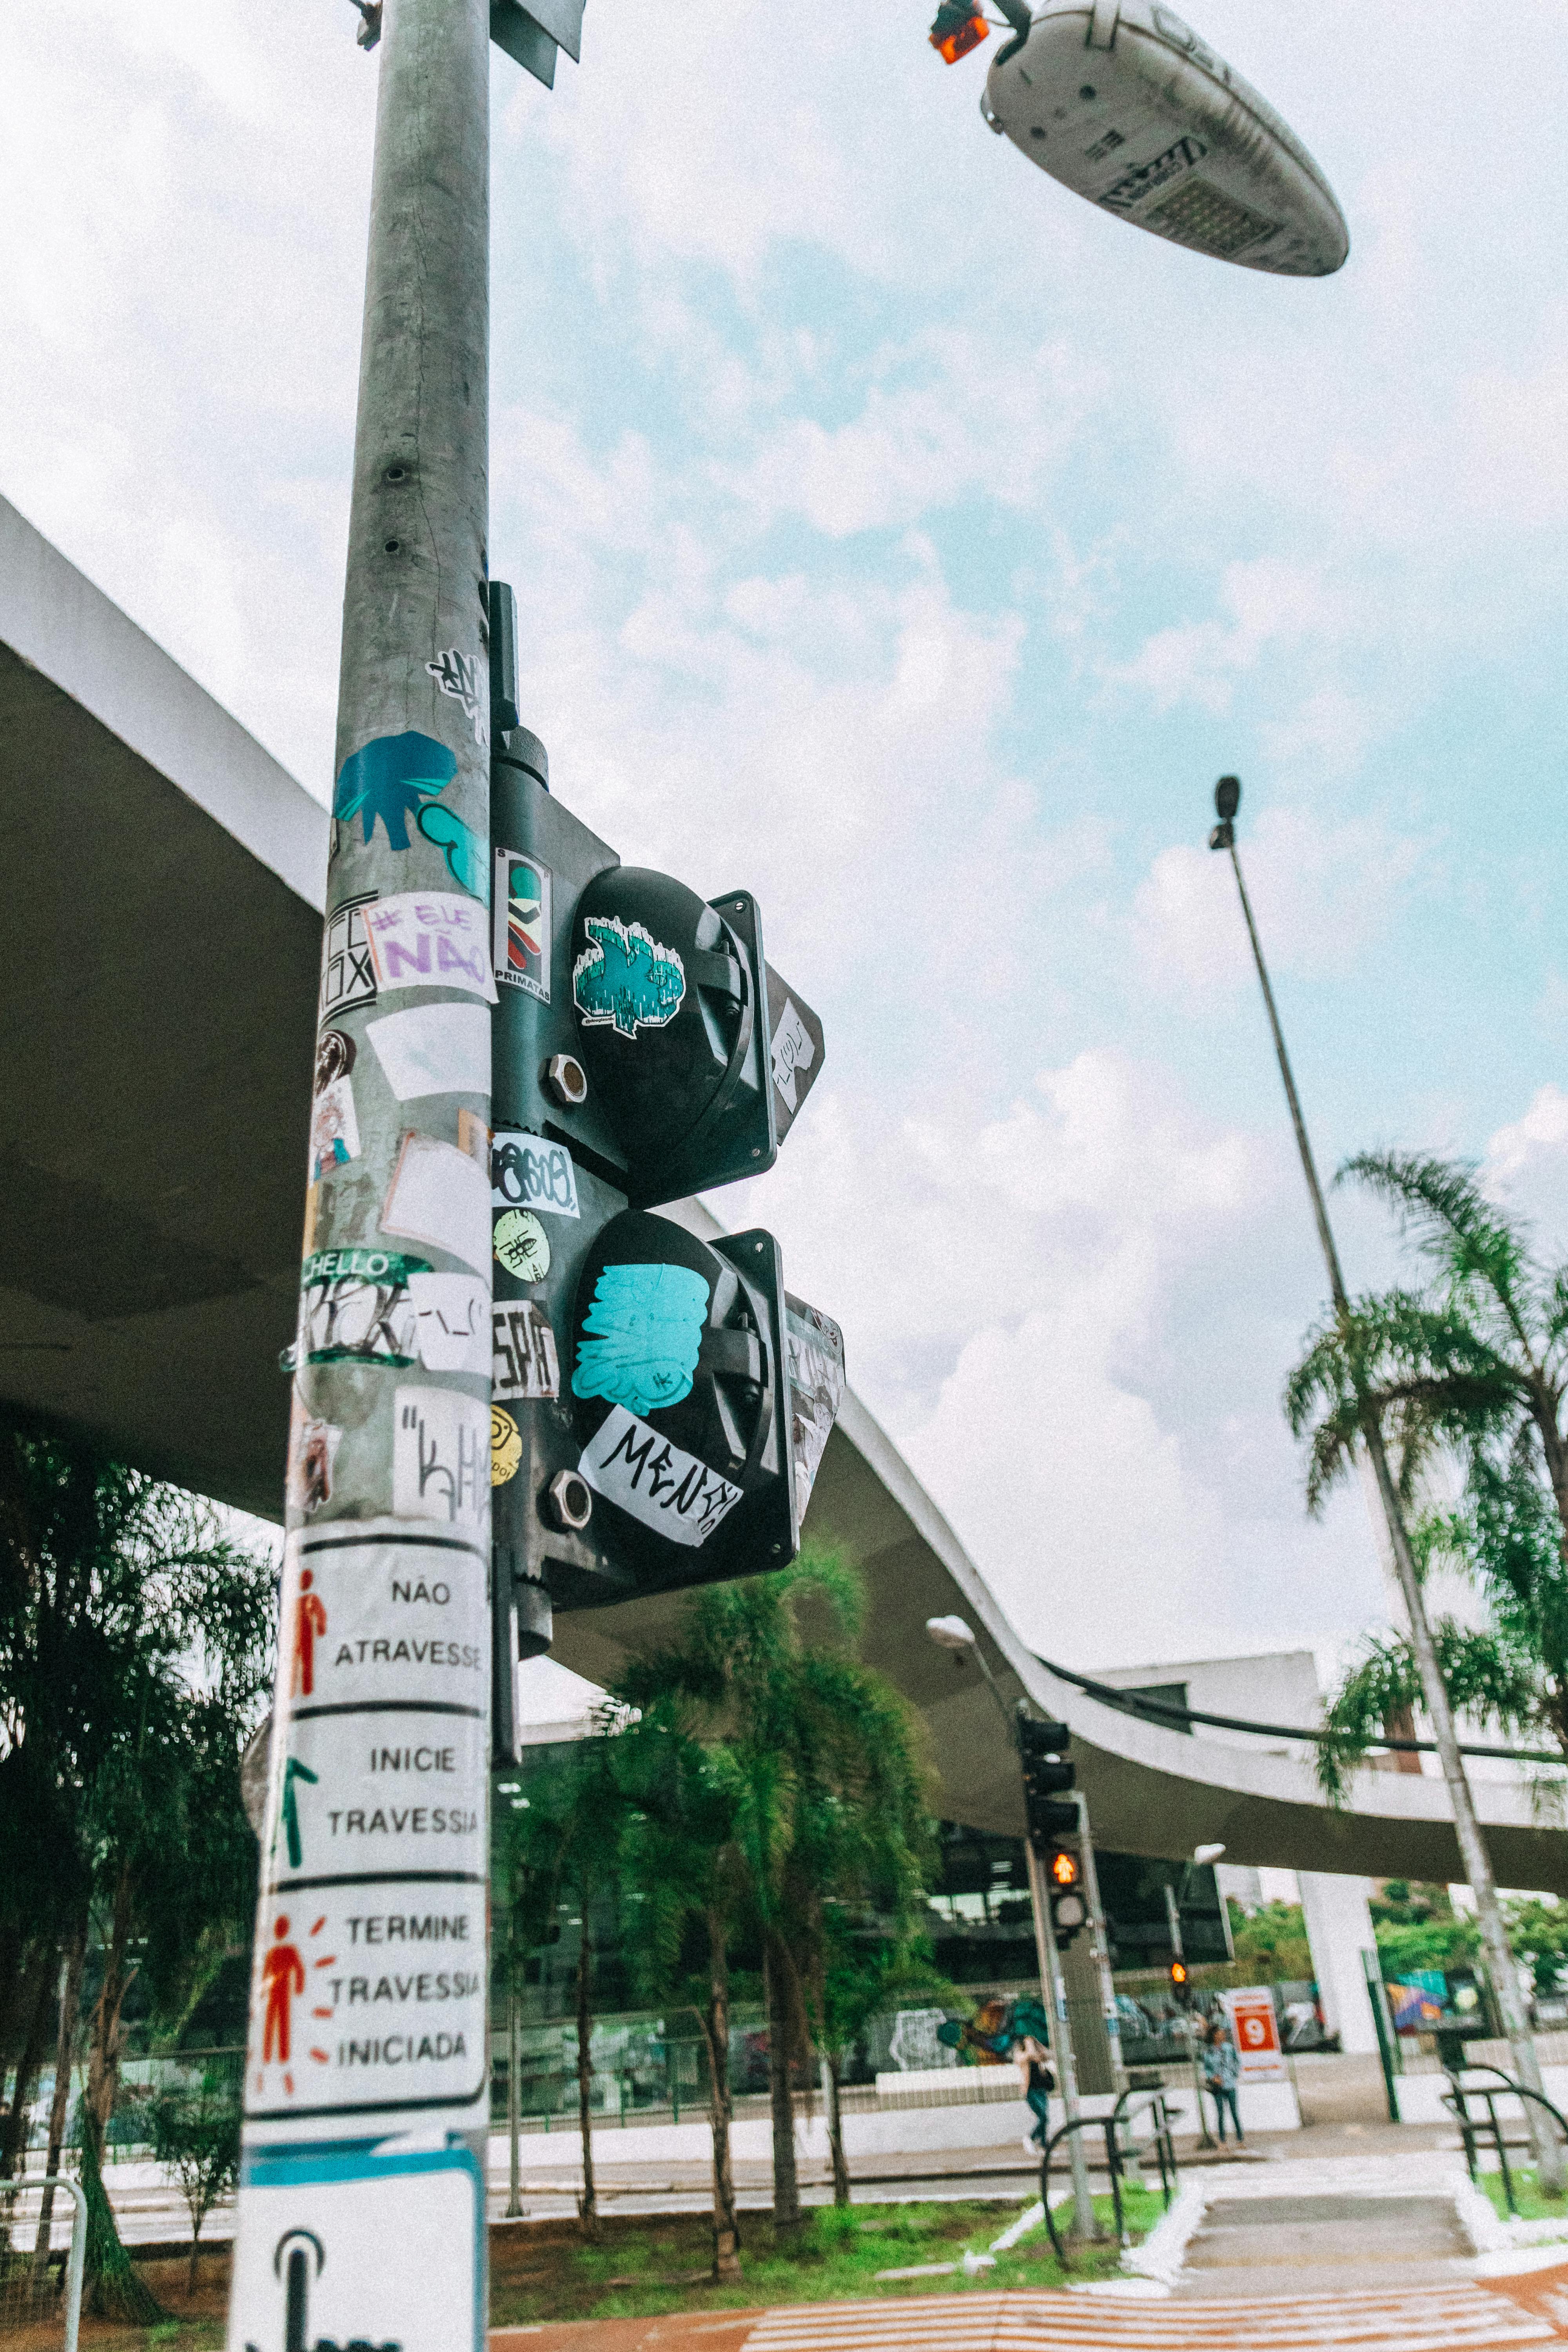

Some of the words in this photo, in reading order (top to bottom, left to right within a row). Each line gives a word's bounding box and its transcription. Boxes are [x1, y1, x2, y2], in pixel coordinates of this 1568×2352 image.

[498, 849, 506, 857] S
[384, 929, 485, 984] NÃO
[495, 970, 550, 1001] PRIMATAS
[309, 1252, 388, 1277] HELLO
[392, 1575, 450, 1605] NÃO
[371, 1746, 456, 1772] INICIE
[346, 1915, 470, 1944] TERMINE
[338, 2032, 466, 2066] INICIADA
